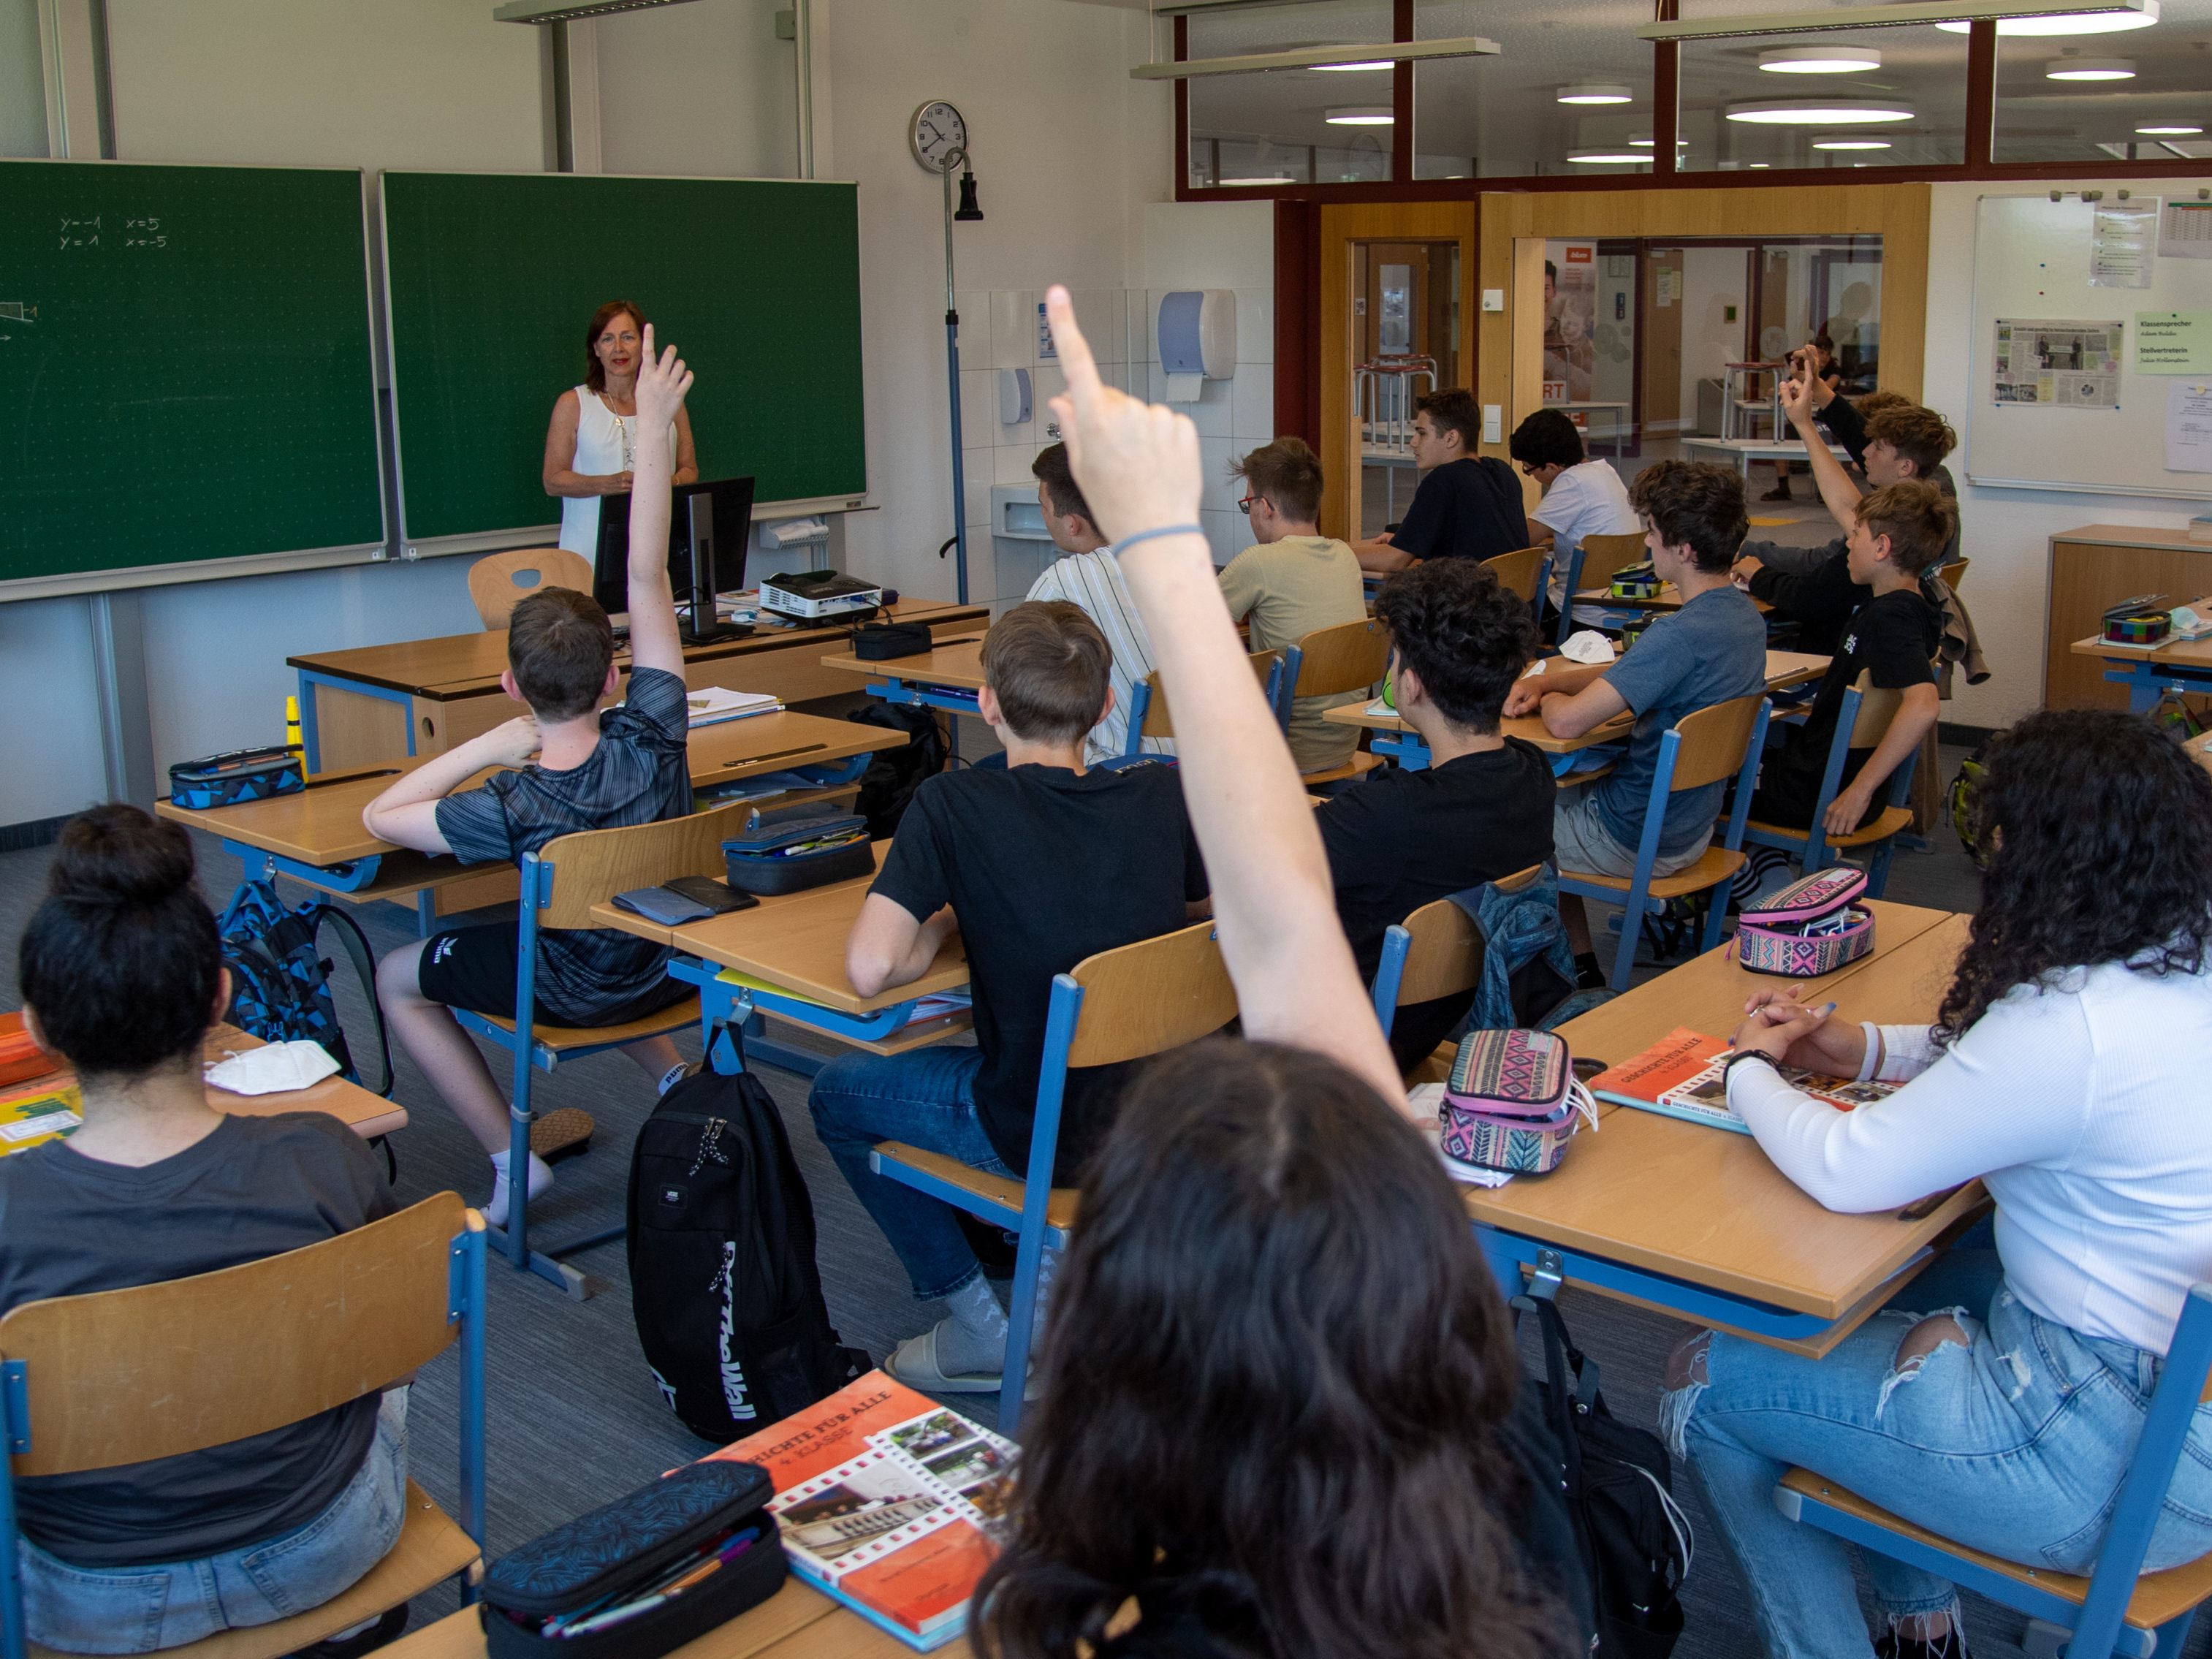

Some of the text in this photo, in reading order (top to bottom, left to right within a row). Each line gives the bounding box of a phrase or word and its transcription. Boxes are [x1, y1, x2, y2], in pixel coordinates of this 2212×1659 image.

[1621, 1058, 1669, 1082] GESCHICHTE
[1681, 1037, 1702, 1052] ALLE
[1672, 1101, 1700, 1112] GESCHICHTE
[748, 1430, 816, 1463] HICHTE
[814, 1413, 851, 1434] FÜR
[851, 1390, 892, 1415] ALLE
[794, 1426, 854, 1459] KLASSE
